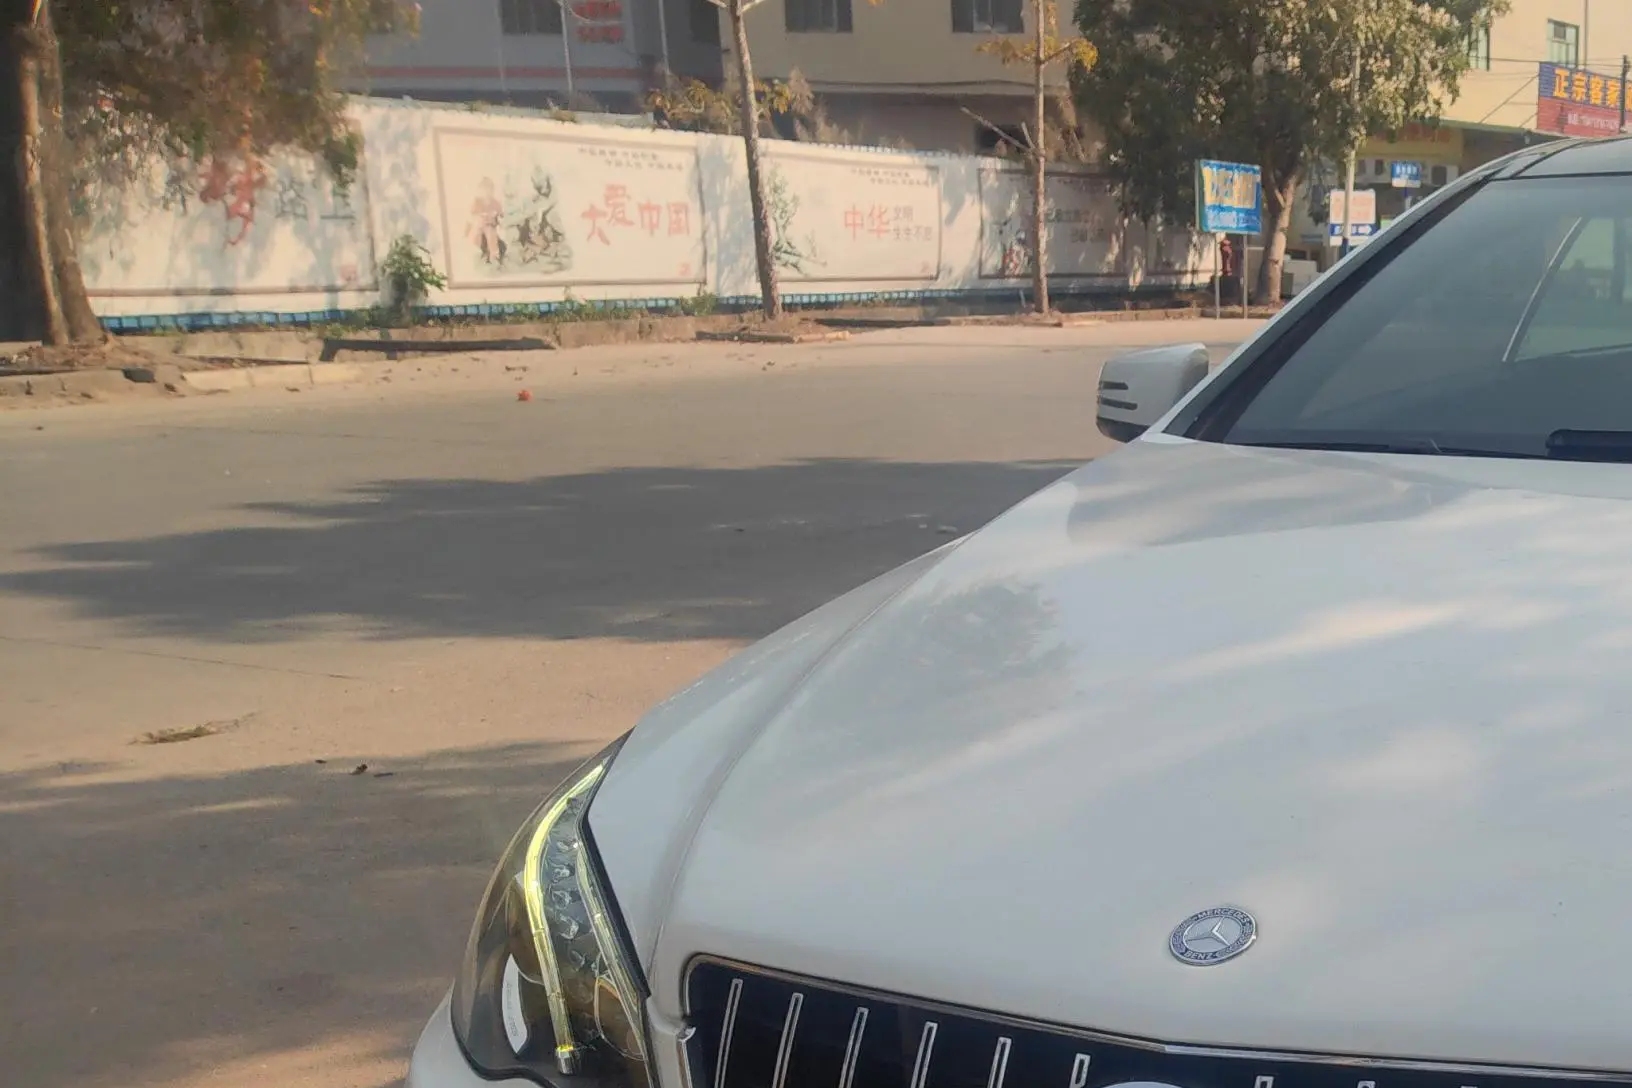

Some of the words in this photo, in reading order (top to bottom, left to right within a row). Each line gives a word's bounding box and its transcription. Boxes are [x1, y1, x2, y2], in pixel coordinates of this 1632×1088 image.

[844, 201, 891, 242] 中华
[1198, 907, 1250, 923] MERCEDES
[1183, 950, 1214, 960] BENZ
